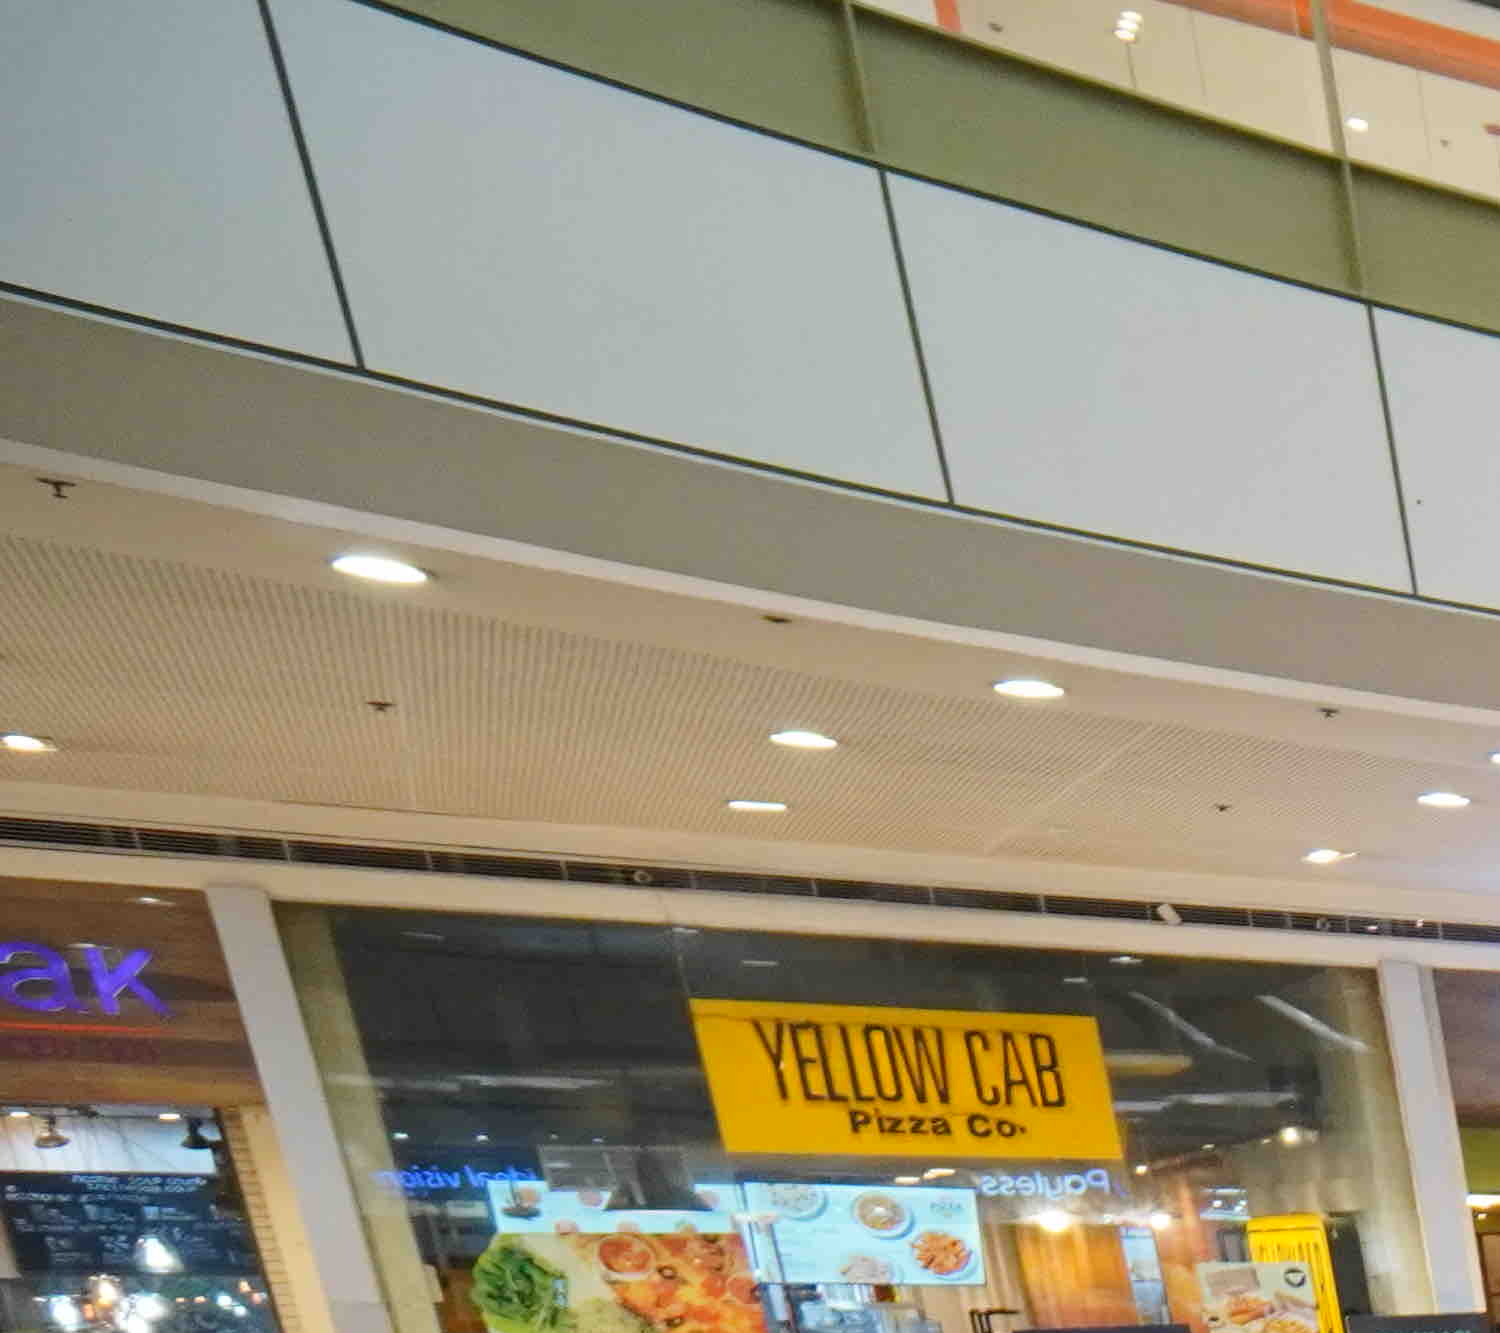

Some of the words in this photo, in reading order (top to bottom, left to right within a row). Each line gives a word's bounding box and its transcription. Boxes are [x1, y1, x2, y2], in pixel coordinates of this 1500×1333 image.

[752, 1017, 951, 1107] YELLOW
[963, 1030, 1067, 1109] CAB
[848, 1107, 952, 1138] Pizza
[967, 1114, 1028, 1139] Co.
